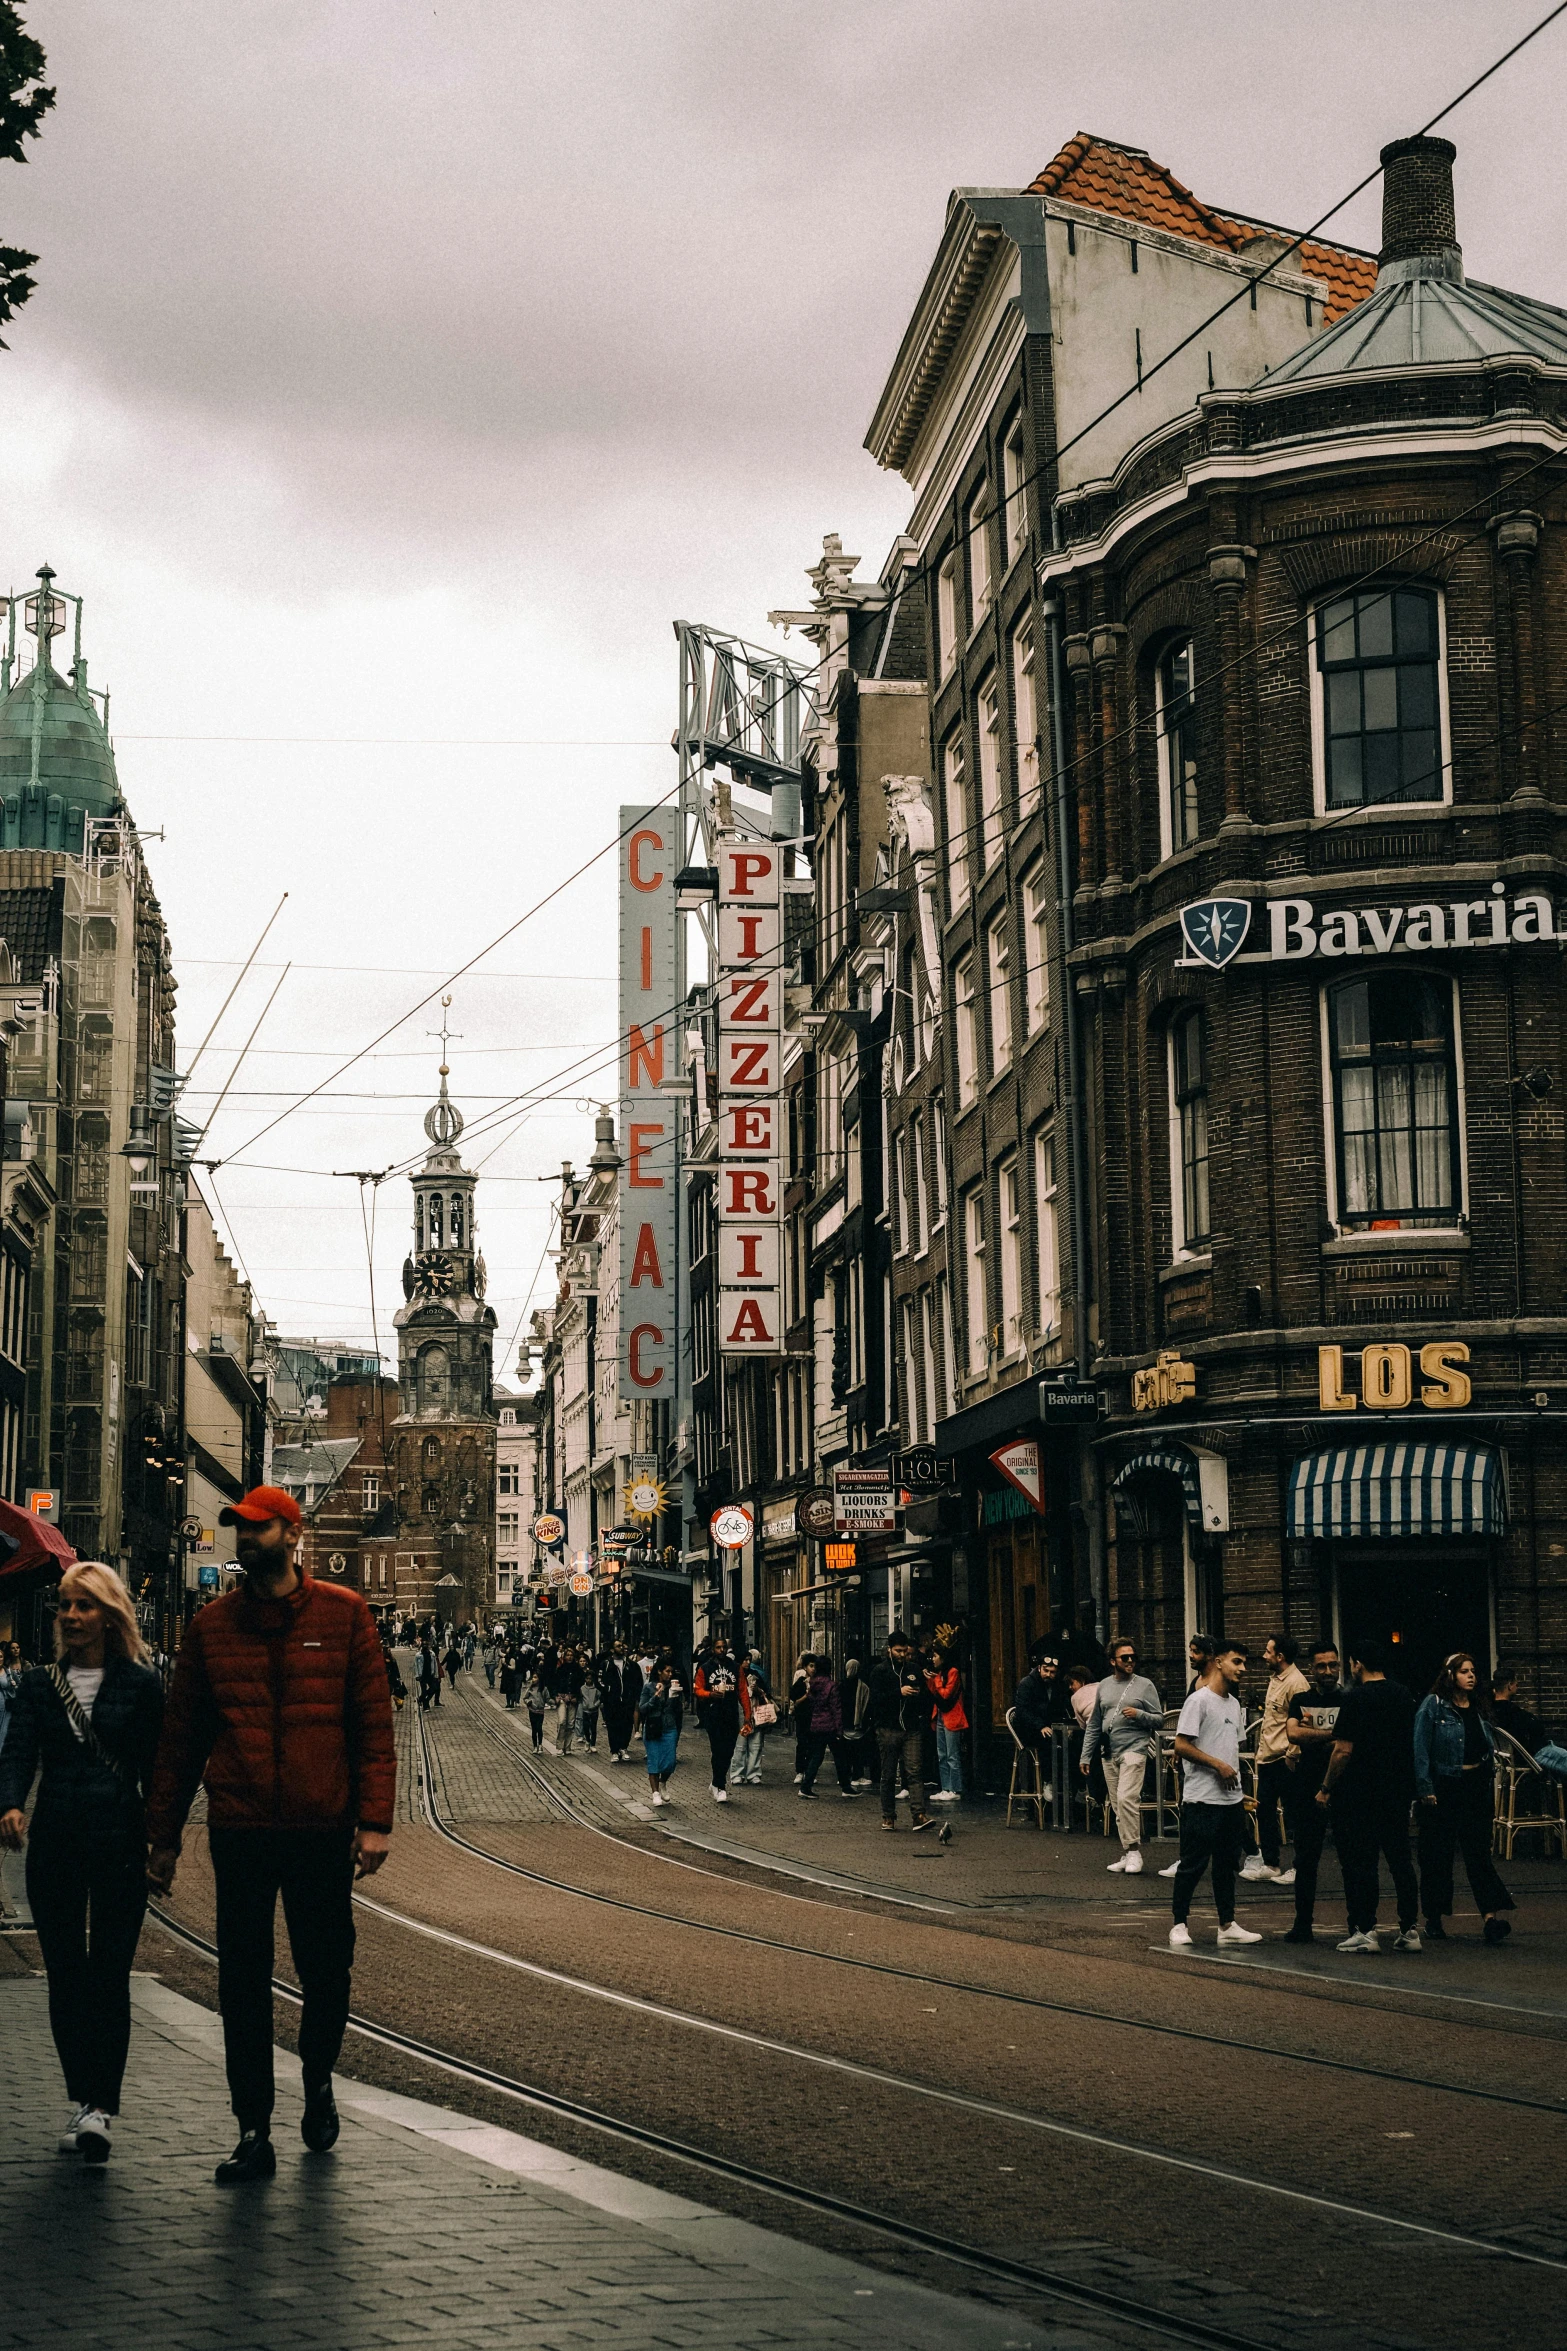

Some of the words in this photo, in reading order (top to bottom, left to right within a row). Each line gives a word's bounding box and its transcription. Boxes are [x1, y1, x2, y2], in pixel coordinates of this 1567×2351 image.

[1266, 881, 1557, 961] Bavaria
[725, 853, 776, 1342] PIZZERIA
[628, 829, 665, 1388] CINEAC
[1319, 1341, 1472, 1411] LOS
[1047, 1390, 1095, 1405] Bavaria
[1024, 1447, 1037, 1457] THE
[1006, 1457, 1037, 1467] ORIGINAL
[900, 1459, 950, 1480] HOF
[1015, 1467, 1029, 1475] SINCE
[842, 1496, 888, 1508] LIQUORS
[984, 1489, 1003, 1525] NEW
[720, 1505, 742, 1514] RENTAL
[844, 1508, 886, 1519] DRINKS
[535, 1520, 560, 1532] BURGER
[846, 1520, 885, 1529] E-SMOKE
[537, 1525, 560, 1539] KING
[609, 1531, 641, 1540] SUBWAY
[710, 1522, 730, 1549] REPARATIE
[740, 1519, 754, 1546] VERKOOP
[825, 1543, 857, 1560] WOK
[826, 1559, 835, 1569] TO
[836, 1559, 856, 1569] WALK
[574, 1576, 588, 1584] DN
[574, 1584, 588, 1592] KN
[708, 1673, 717, 1684] NEW
